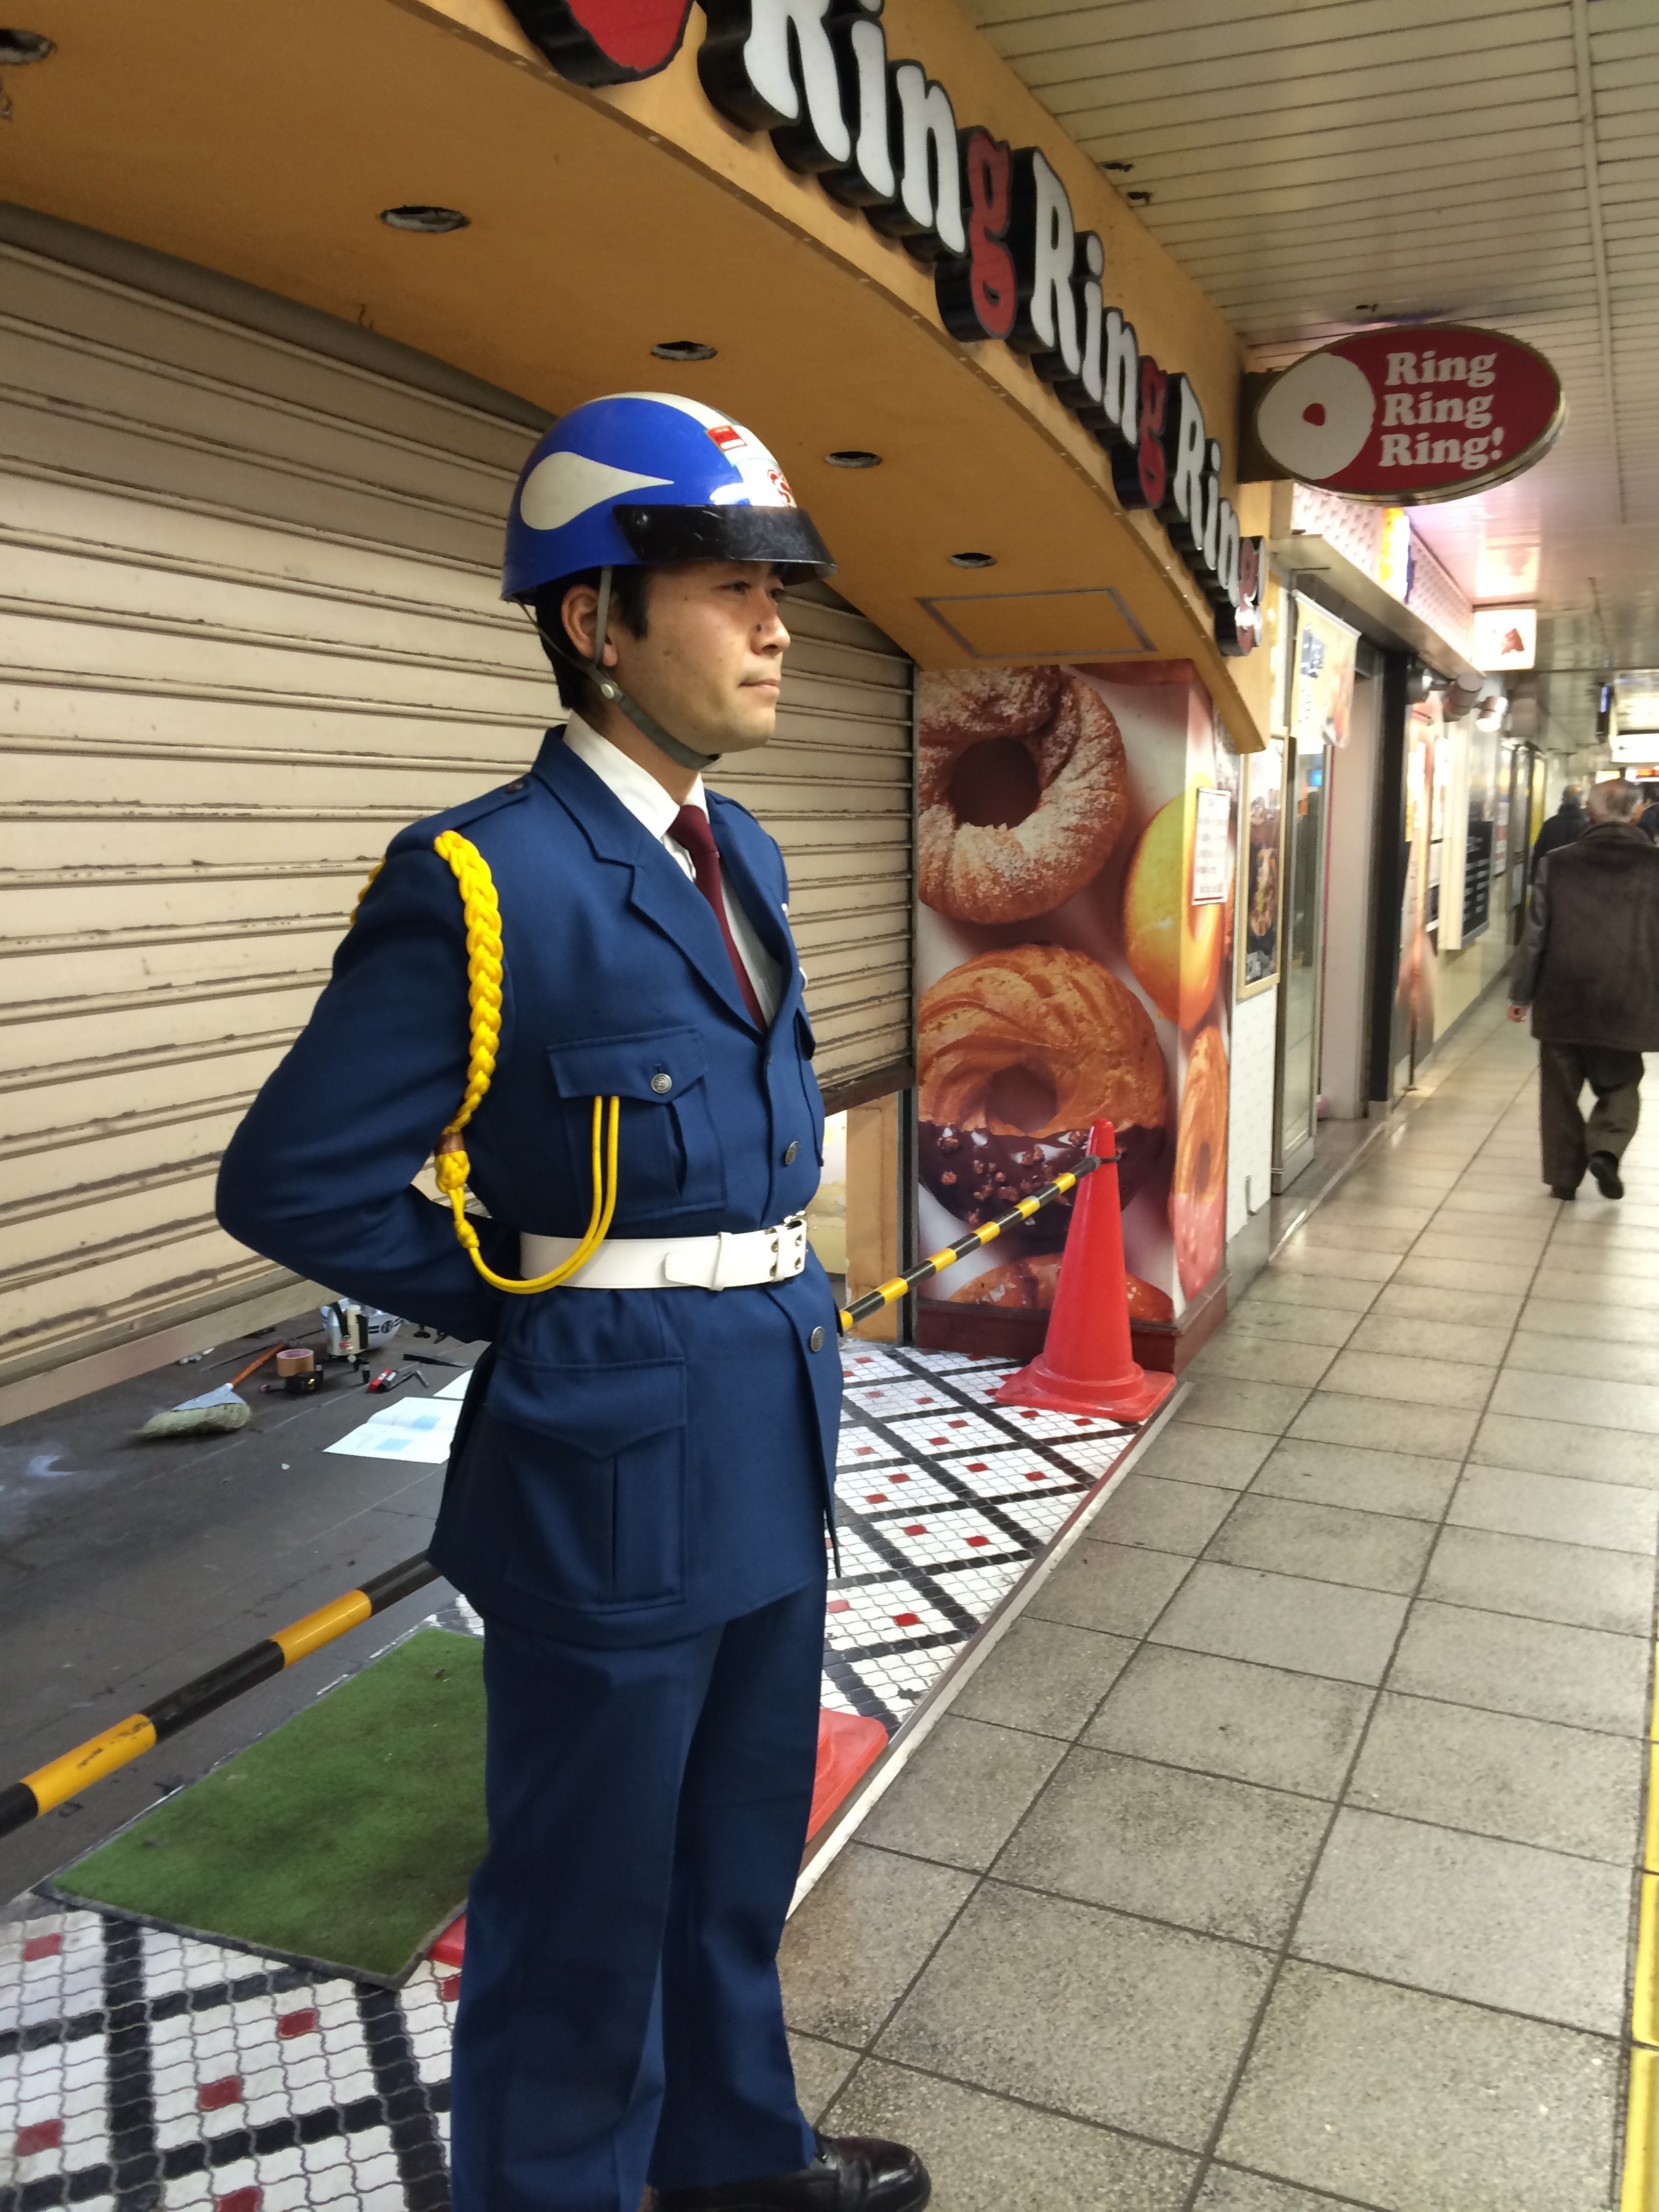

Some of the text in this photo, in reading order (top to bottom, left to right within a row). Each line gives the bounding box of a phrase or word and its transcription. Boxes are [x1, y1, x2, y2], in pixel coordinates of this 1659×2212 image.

[1030, 150, 1165, 506] Ring
[1385, 350, 1497, 388] Ring
[1381, 391, 1494, 428] Ring
[1378, 427, 1504, 469] Ring!
